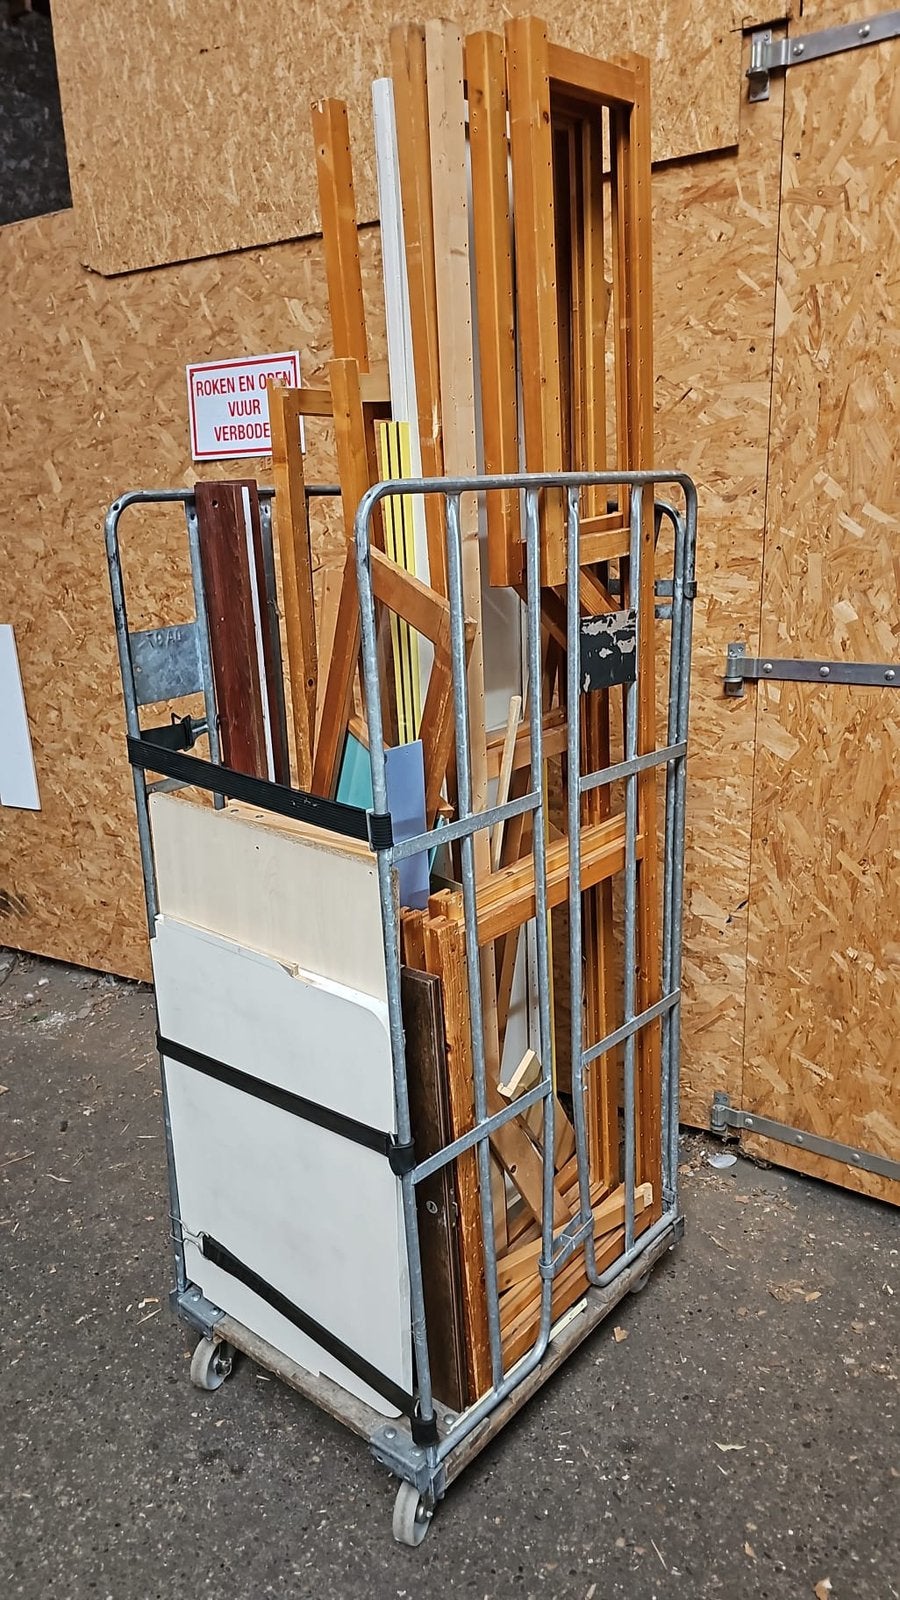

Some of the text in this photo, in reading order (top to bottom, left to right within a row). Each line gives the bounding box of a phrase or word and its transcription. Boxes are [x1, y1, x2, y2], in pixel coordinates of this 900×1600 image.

[196, 377, 235, 396] ROKEN
[239, 375, 254, 391] EN
[228, 399, 261, 416] VUUR
[214, 422, 270, 441] VERBODE
